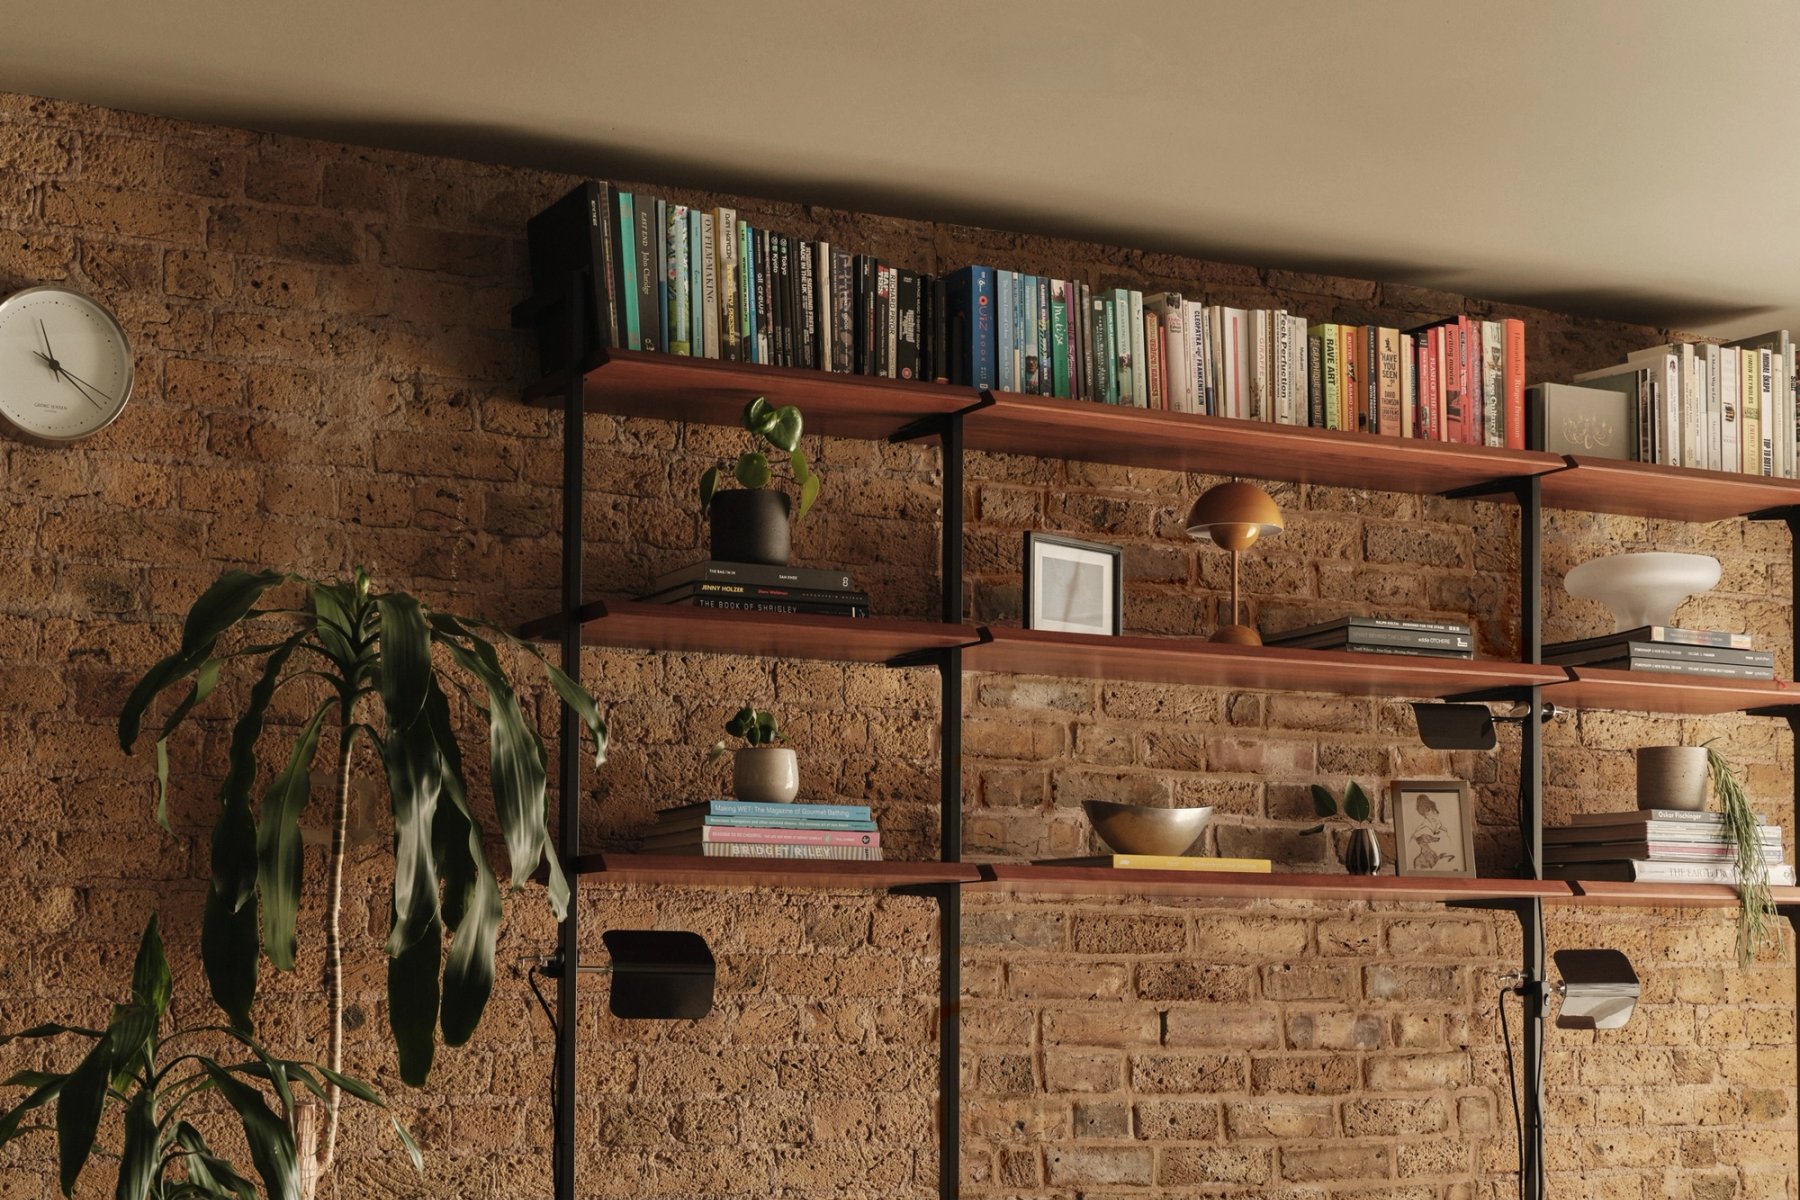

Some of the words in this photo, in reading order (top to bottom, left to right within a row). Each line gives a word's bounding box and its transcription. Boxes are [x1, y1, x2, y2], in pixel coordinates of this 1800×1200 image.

[704, 219, 712, 234] ON
[641, 251, 650, 267] John
[704, 236, 714, 303] FILM-MAKING
[642, 268, 651, 295] Claridge
[802, 284, 808, 294] UK
[1326, 338, 1334, 364] RAVE
[1383, 370, 1397, 379] SEEN
[1490, 396, 1498, 433] Culture
[701, 584, 721, 592] JENNY
[700, 600, 715, 608] THE
[718, 601, 740, 609] BOOK
[743, 602, 755, 610] OF
[758, 603, 798, 614] SHRIGLEY
[714, 804, 736, 813] Making
[766, 807, 793, 816] Magazine
[801, 808, 826, 816] Gourmet
[1675, 811, 1702, 820] Fischinger
[732, 845, 788, 856] BRIDGET
[794, 846, 831, 857] RILEY
